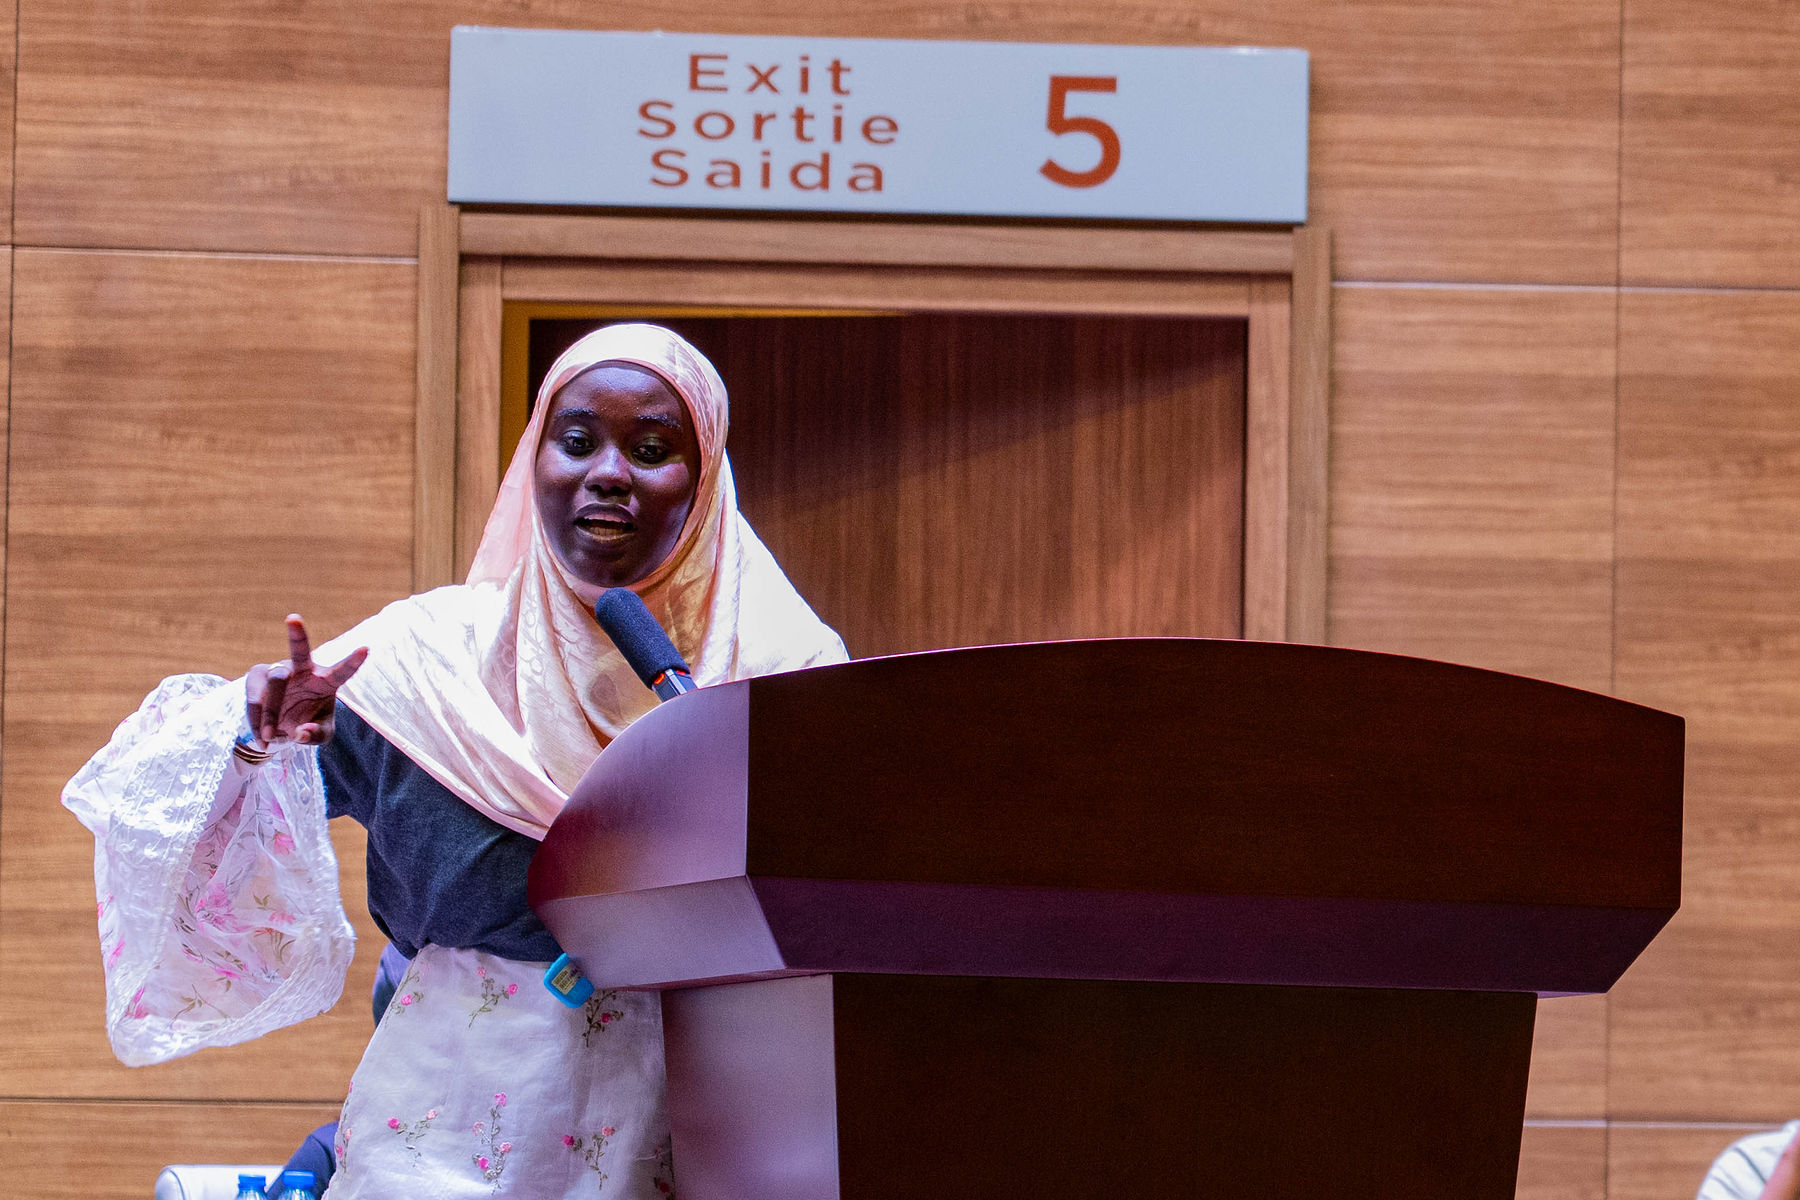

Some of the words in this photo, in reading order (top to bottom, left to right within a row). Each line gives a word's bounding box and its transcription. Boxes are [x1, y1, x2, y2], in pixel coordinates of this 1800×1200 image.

[688, 53, 851, 96] Exit
[637, 99, 900, 145] Sortie
[1038, 74, 1122, 189] 5
[650, 148, 884, 193] Saida
